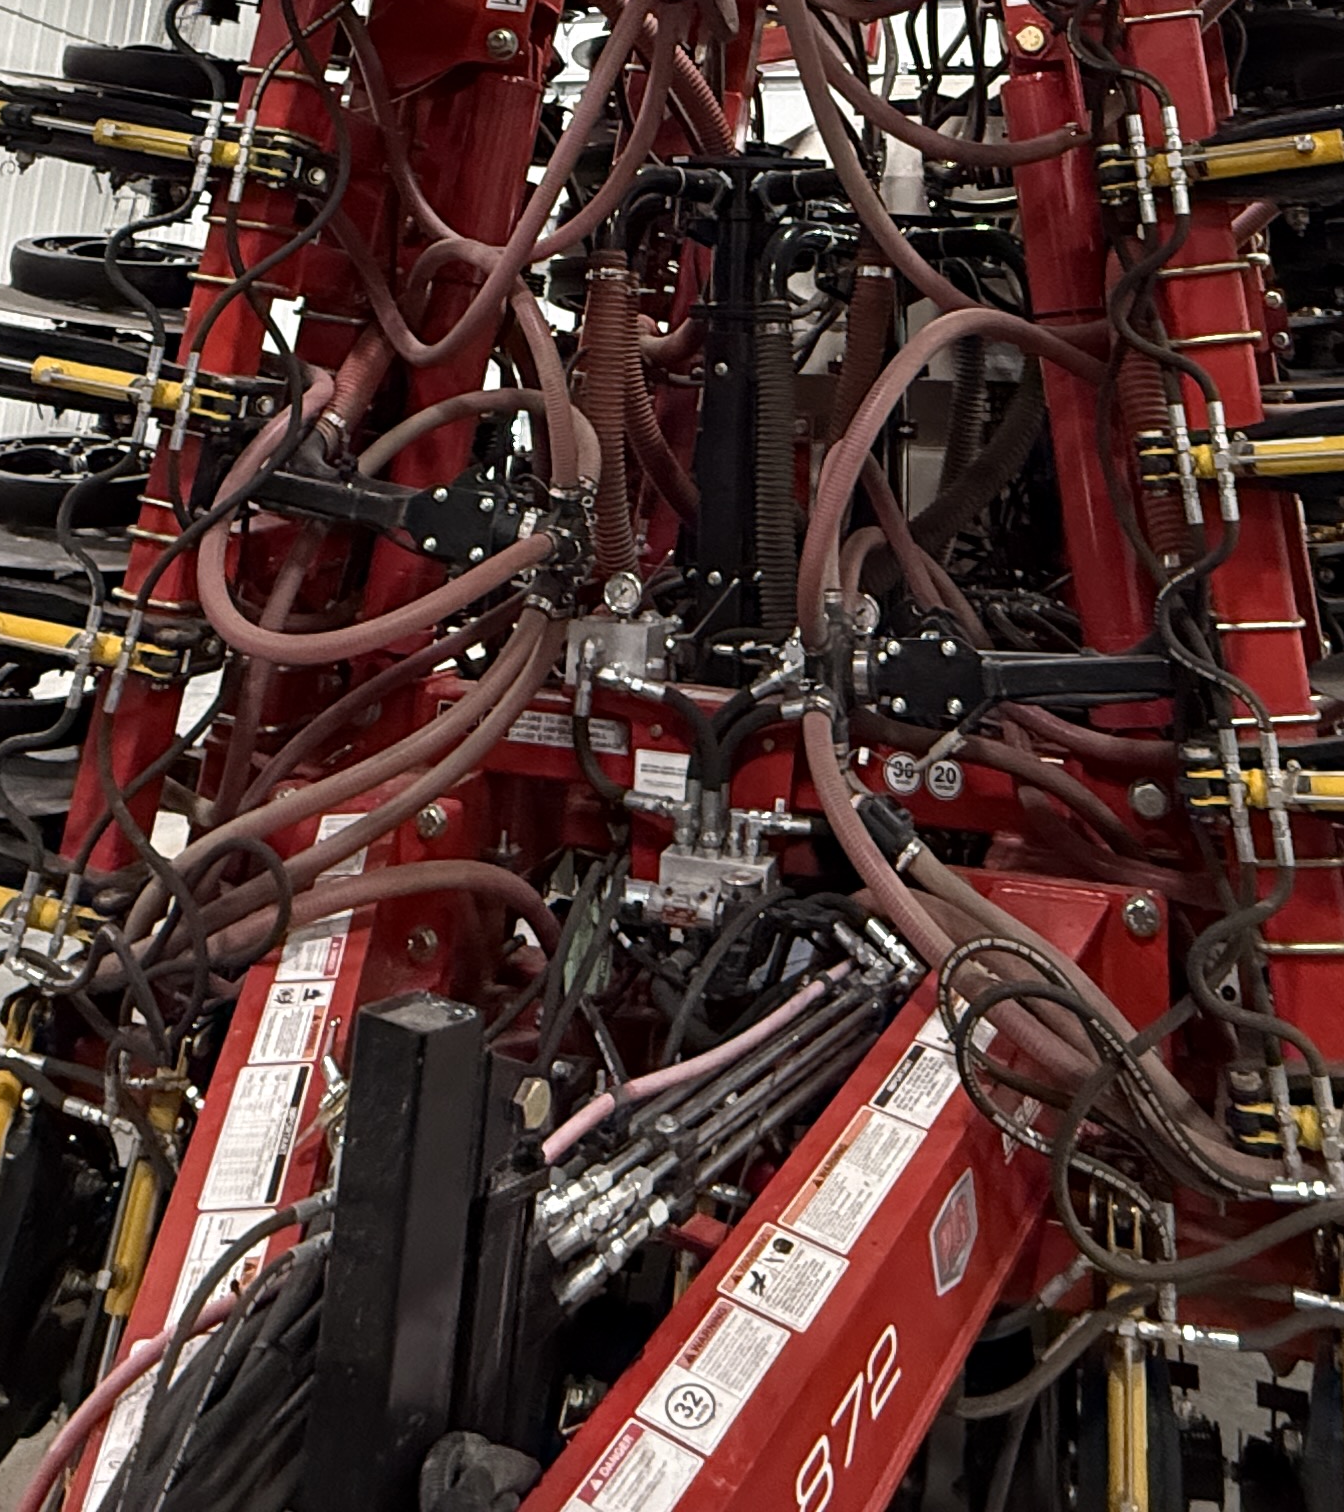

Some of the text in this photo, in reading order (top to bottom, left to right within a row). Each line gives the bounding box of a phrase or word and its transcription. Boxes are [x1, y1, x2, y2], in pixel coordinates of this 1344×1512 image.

[934, 766, 957, 784] 20
[693, 1305, 728, 1353] WARNING
[673, 1389, 704, 1420] 32
[795, 1324, 902, 1512] 872
[599, 1433, 635, 1478] DANGER
